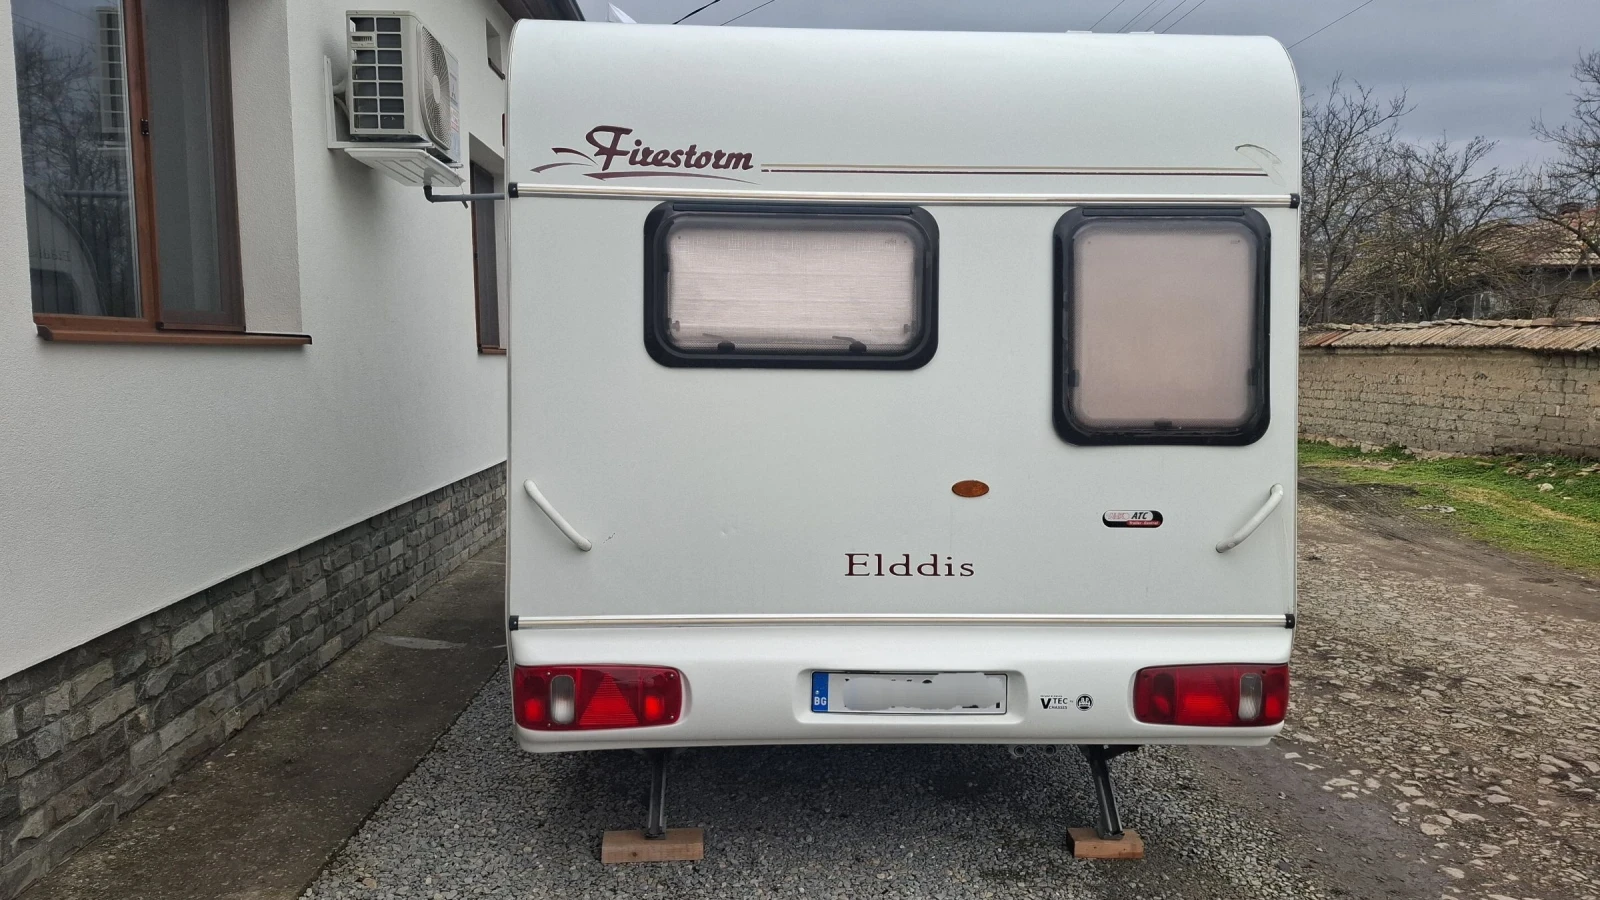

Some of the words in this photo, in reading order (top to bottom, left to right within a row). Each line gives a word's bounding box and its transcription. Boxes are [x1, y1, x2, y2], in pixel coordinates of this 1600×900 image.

[585, 125, 754, 171] Firestorm
[844, 553, 975, 577] Elddis
[814, 696, 827, 706] BG
